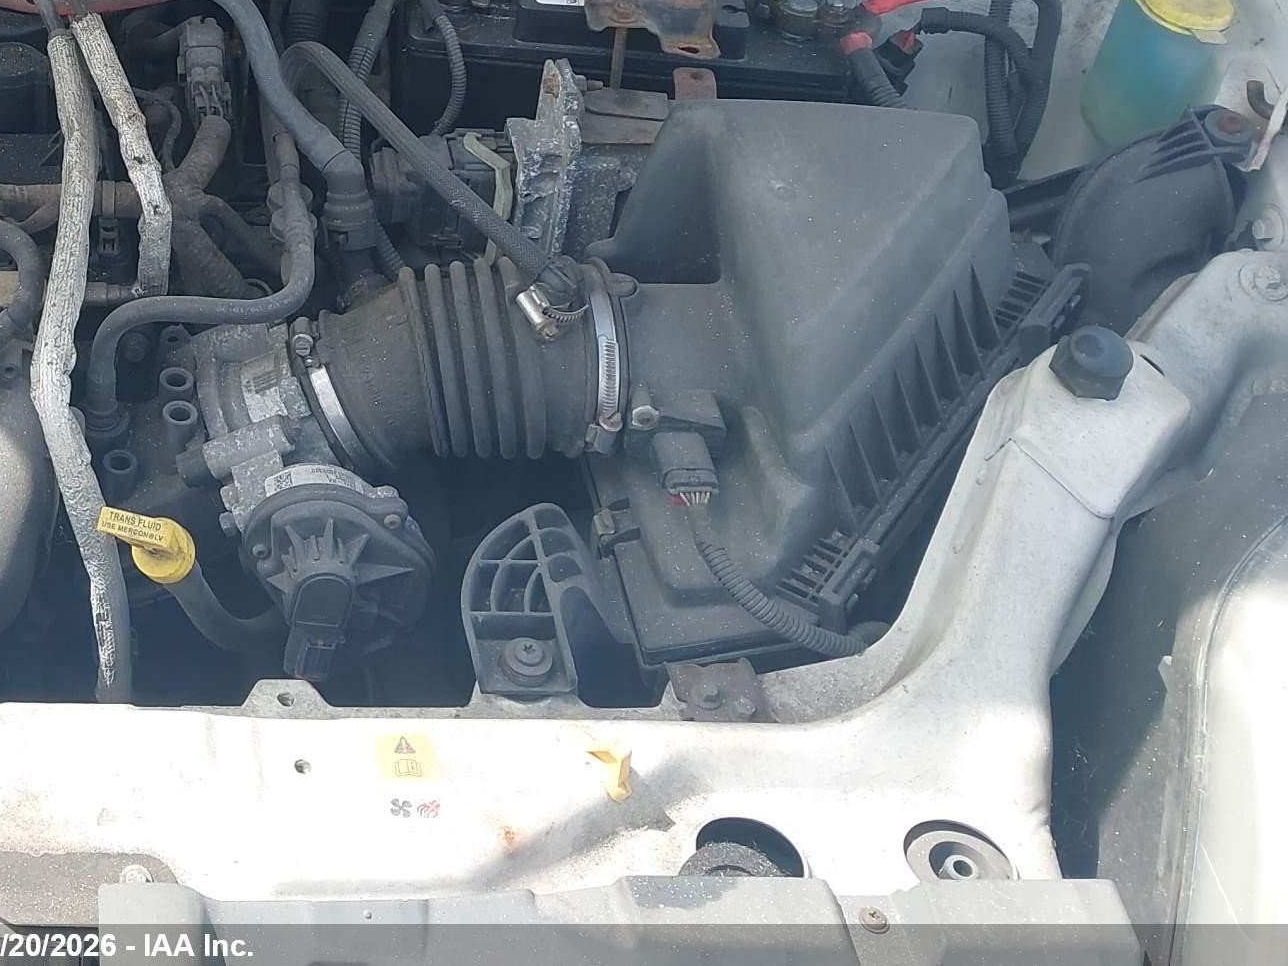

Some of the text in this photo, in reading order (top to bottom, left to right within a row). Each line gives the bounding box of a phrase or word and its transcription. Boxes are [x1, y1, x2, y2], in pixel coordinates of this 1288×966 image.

[101, 521, 116, 530] USE
[109, 511, 162, 531] TRANS FLUID
